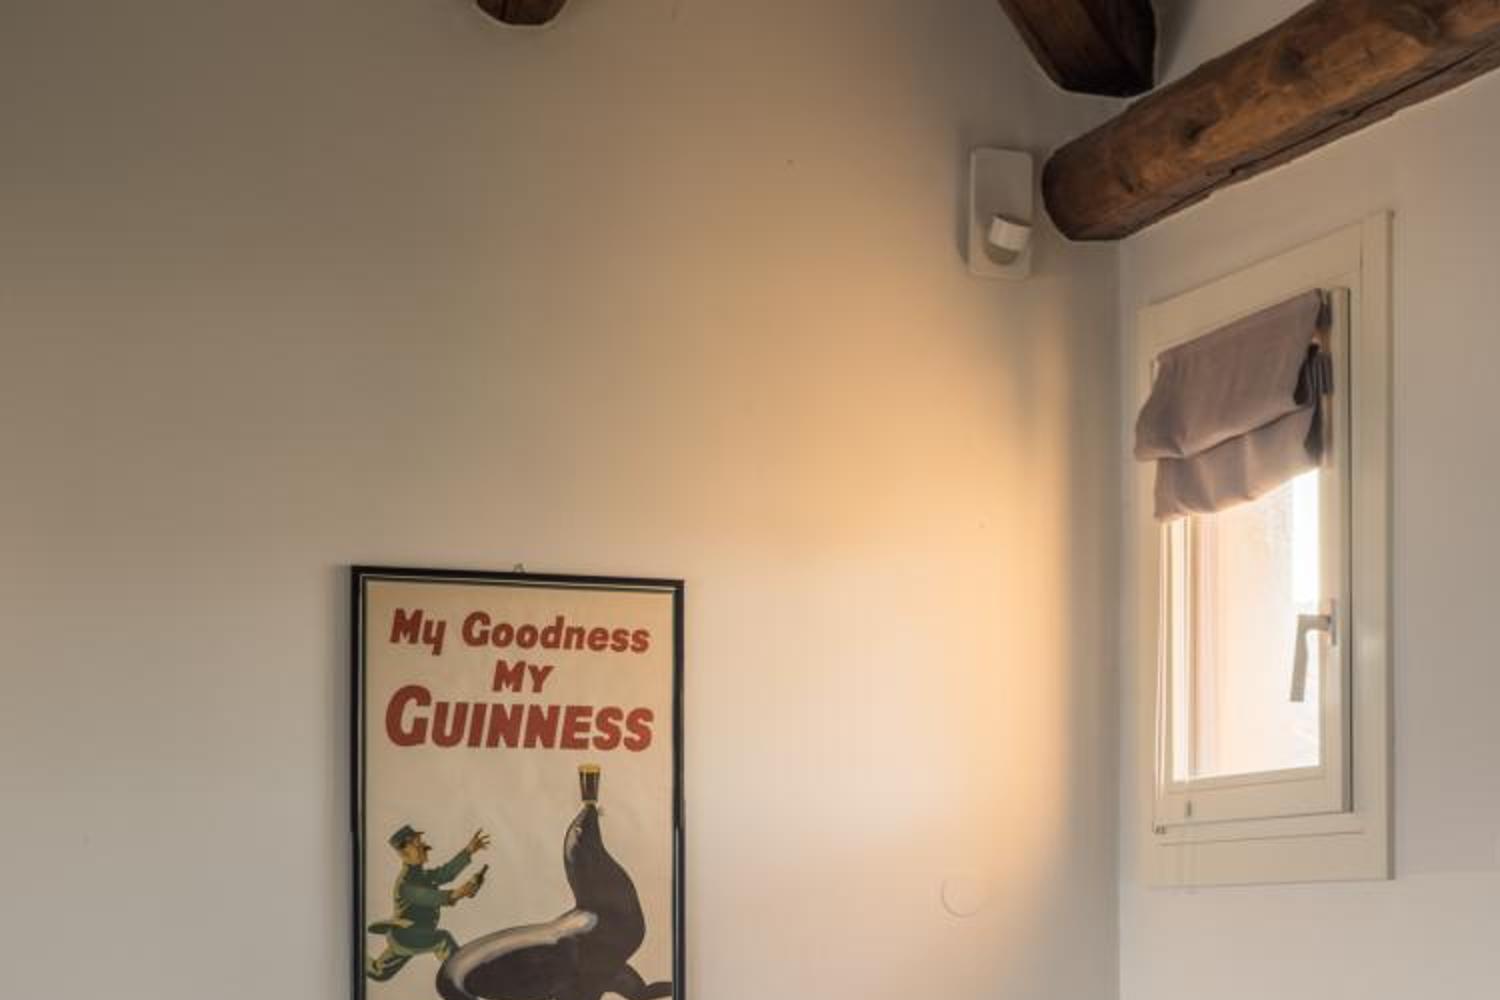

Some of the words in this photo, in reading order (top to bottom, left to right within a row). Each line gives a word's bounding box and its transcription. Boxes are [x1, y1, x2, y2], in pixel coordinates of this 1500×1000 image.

[389, 608, 447, 656] My
[461, 611, 651, 653] Goodness
[492, 659, 555, 693] MY
[385, 684, 655, 752] GUINNESS
